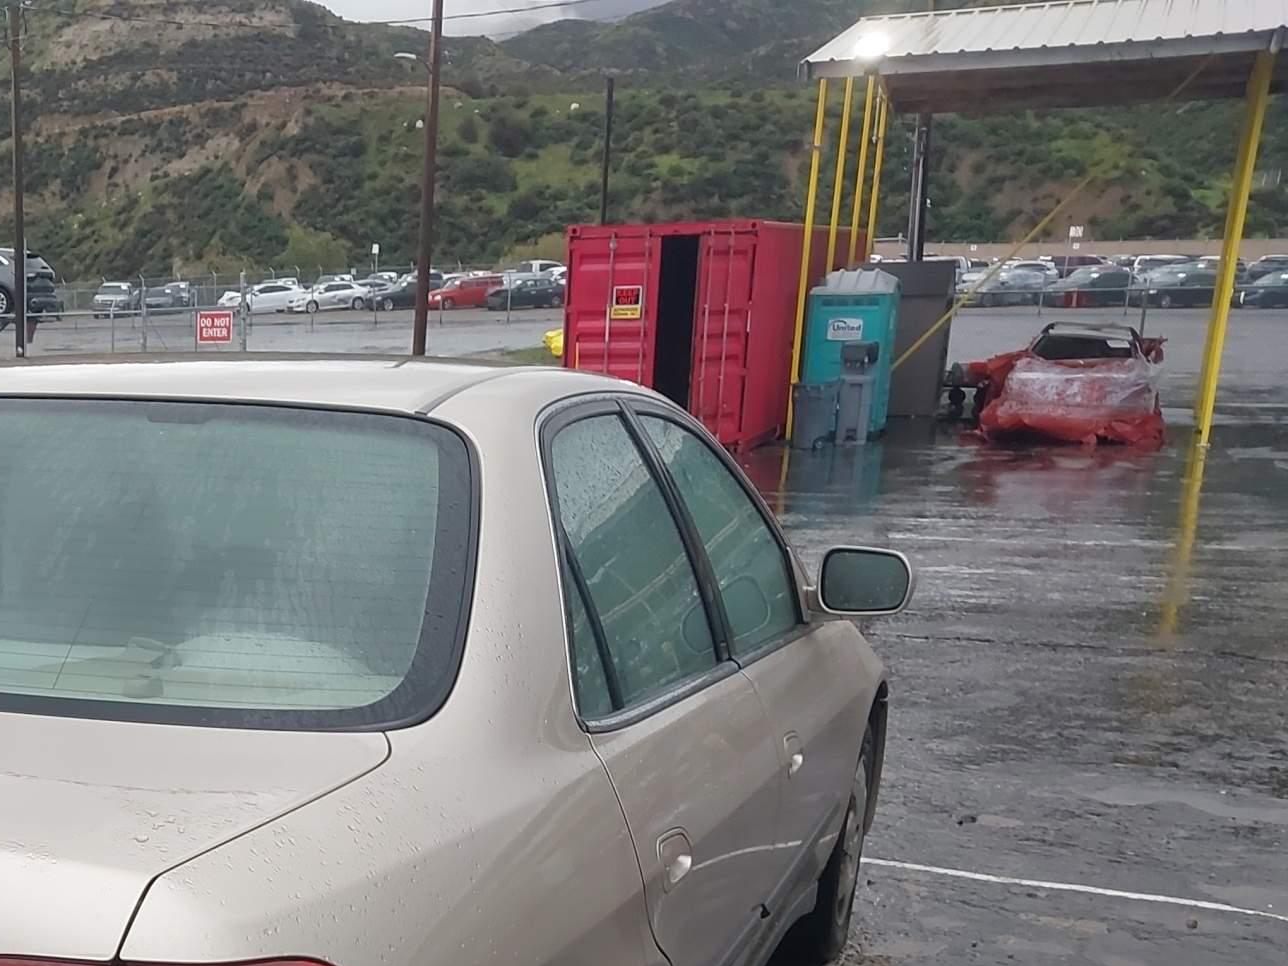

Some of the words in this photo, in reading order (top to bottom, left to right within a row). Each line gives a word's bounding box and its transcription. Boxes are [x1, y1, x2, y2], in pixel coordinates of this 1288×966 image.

[619, 296, 637, 304] OUT
[200, 317, 212, 327] DO
[214, 317, 230, 327] NOT
[202, 327, 228, 337] ENTER
[832, 323, 861, 332] United
